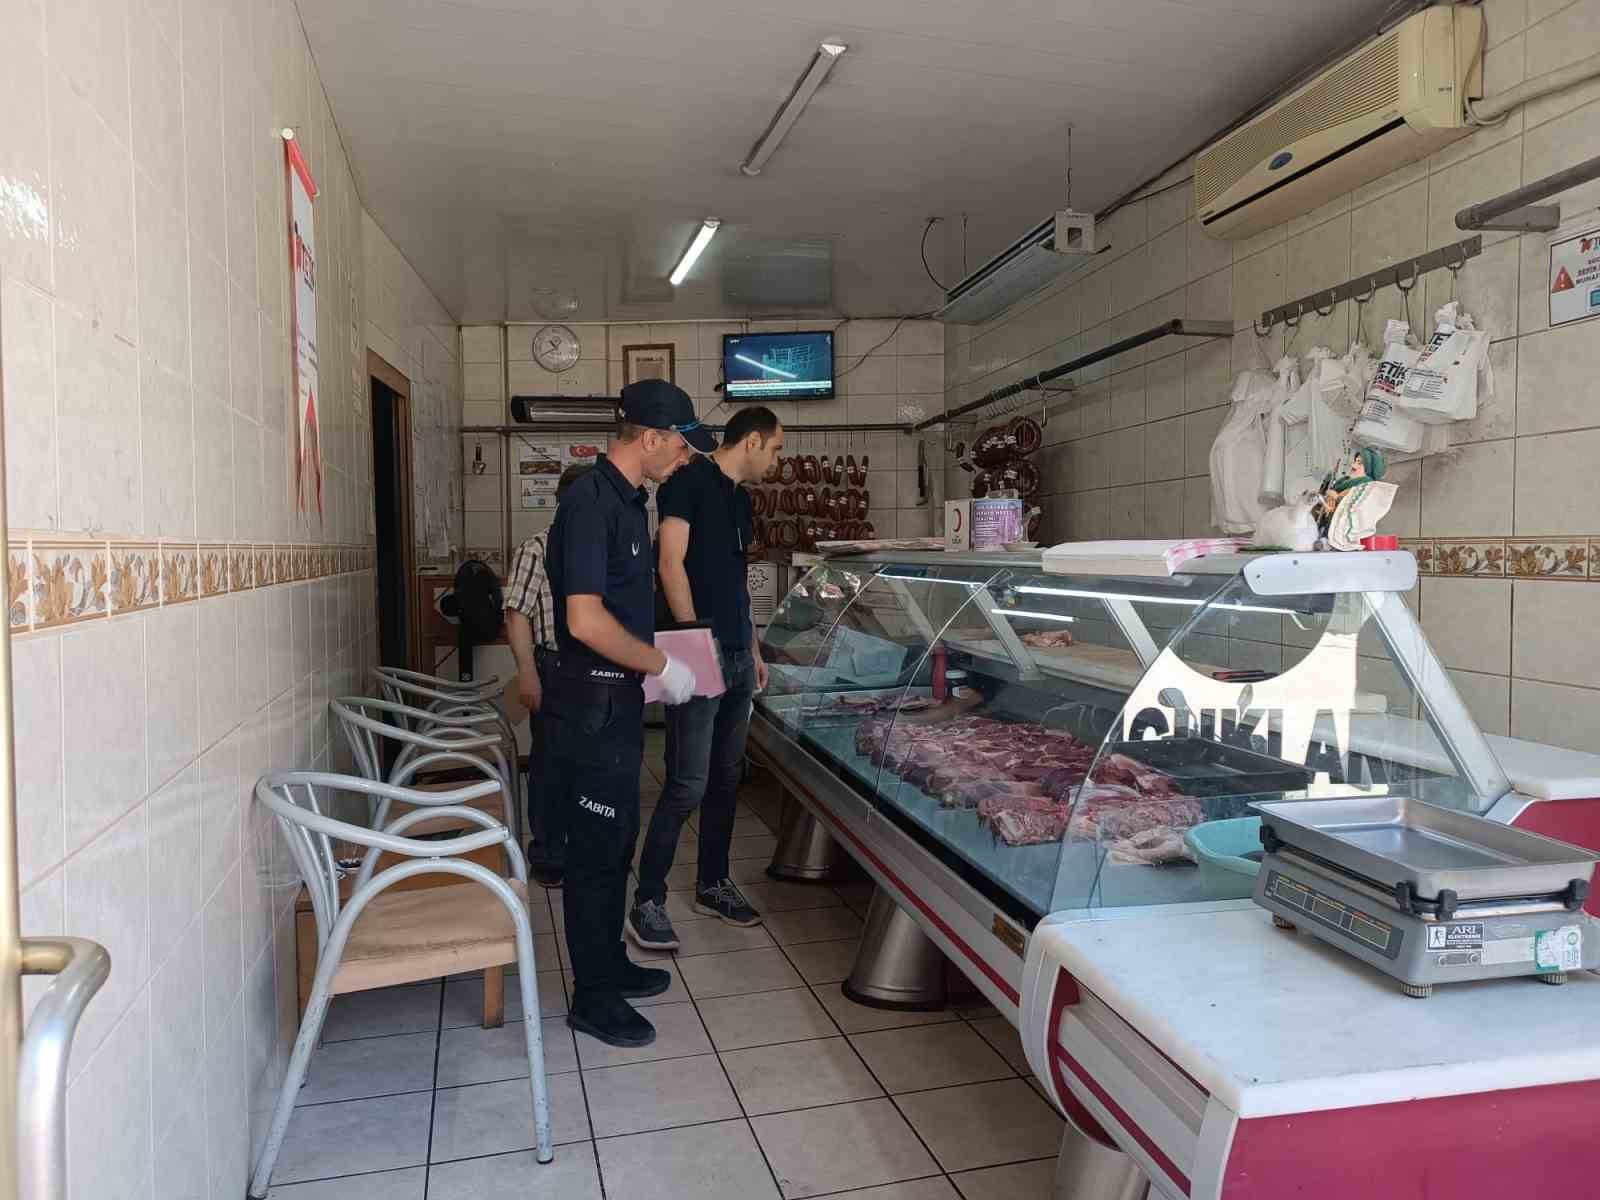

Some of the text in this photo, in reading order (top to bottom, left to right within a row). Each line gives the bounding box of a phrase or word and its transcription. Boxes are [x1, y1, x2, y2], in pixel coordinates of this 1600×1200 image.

[590, 669, 625, 679] ZABITA
[578, 796, 616, 819] ZABITA
[1452, 926, 1477, 935] ARI
